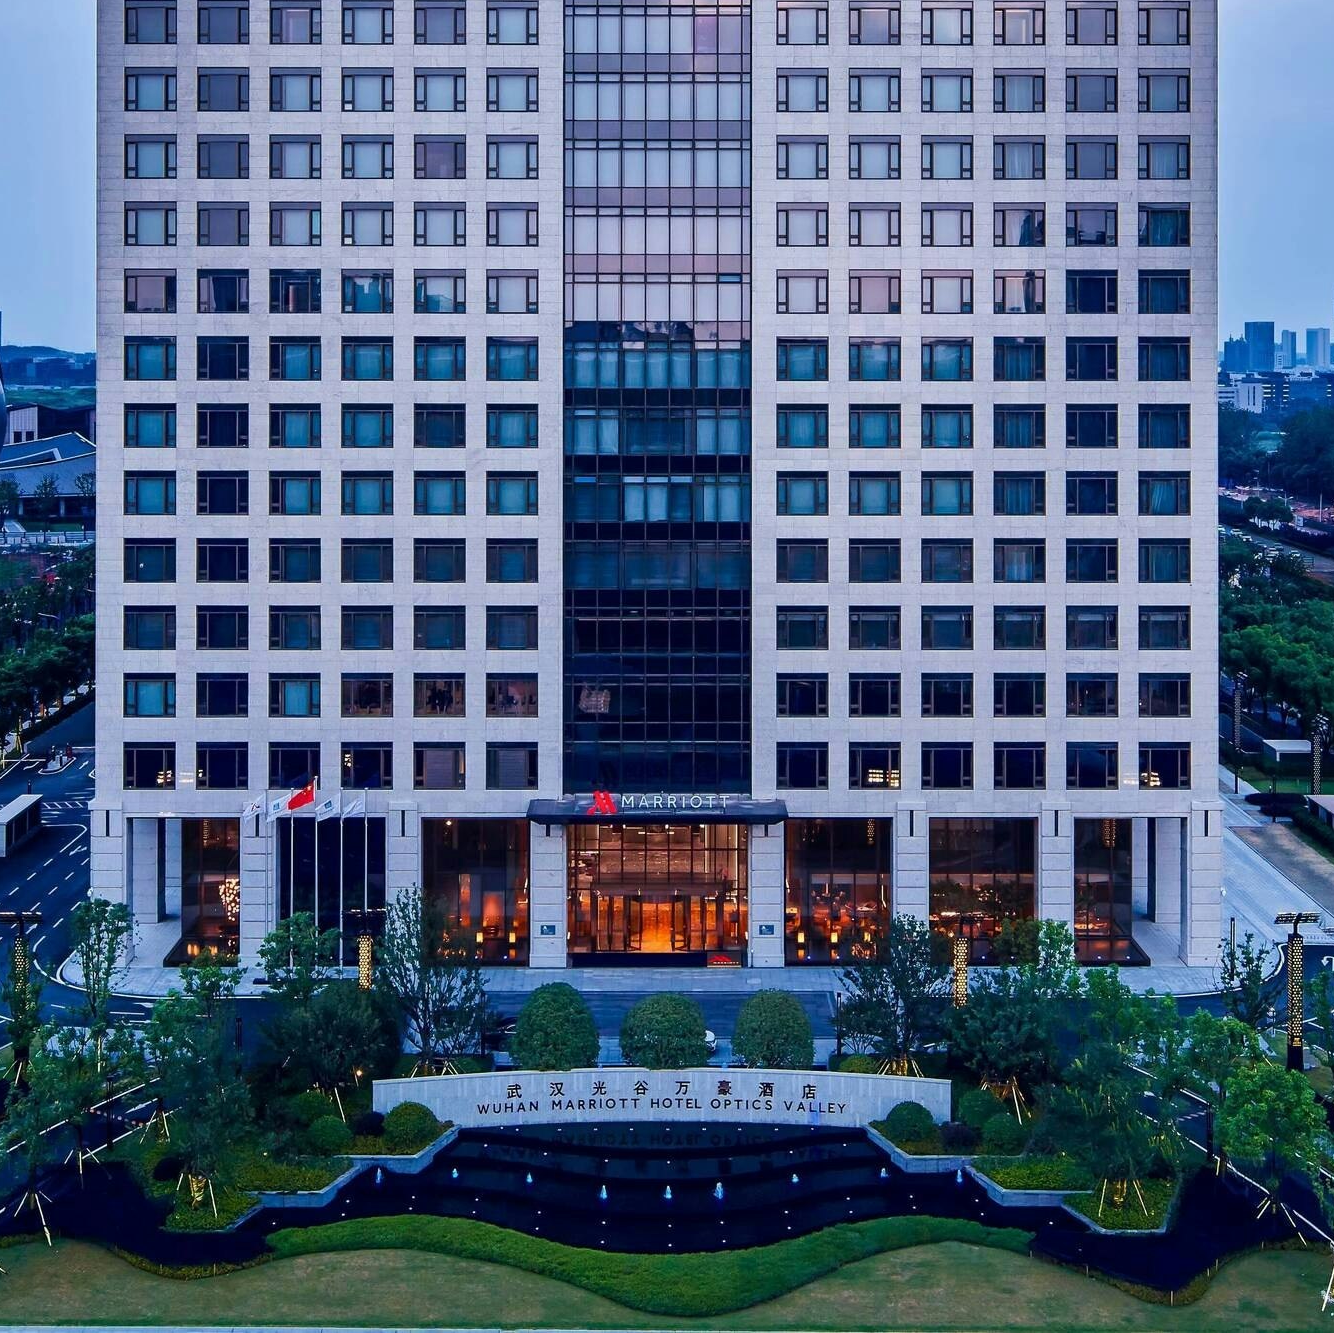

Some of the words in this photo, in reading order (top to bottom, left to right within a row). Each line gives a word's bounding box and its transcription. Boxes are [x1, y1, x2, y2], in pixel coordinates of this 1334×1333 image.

[621, 795, 730, 809] MARRIOTT
[506, 1080, 817, 1100] 武汉光谷万豪酒店
[477, 1100, 539, 1115] WUHAN
[551, 1098, 640, 1111] MARRIOTT
[650, 1097, 702, 1109] HOTEL
[710, 1098, 773, 1111] OPTICS
[783, 1100, 847, 1115] VALLEY
